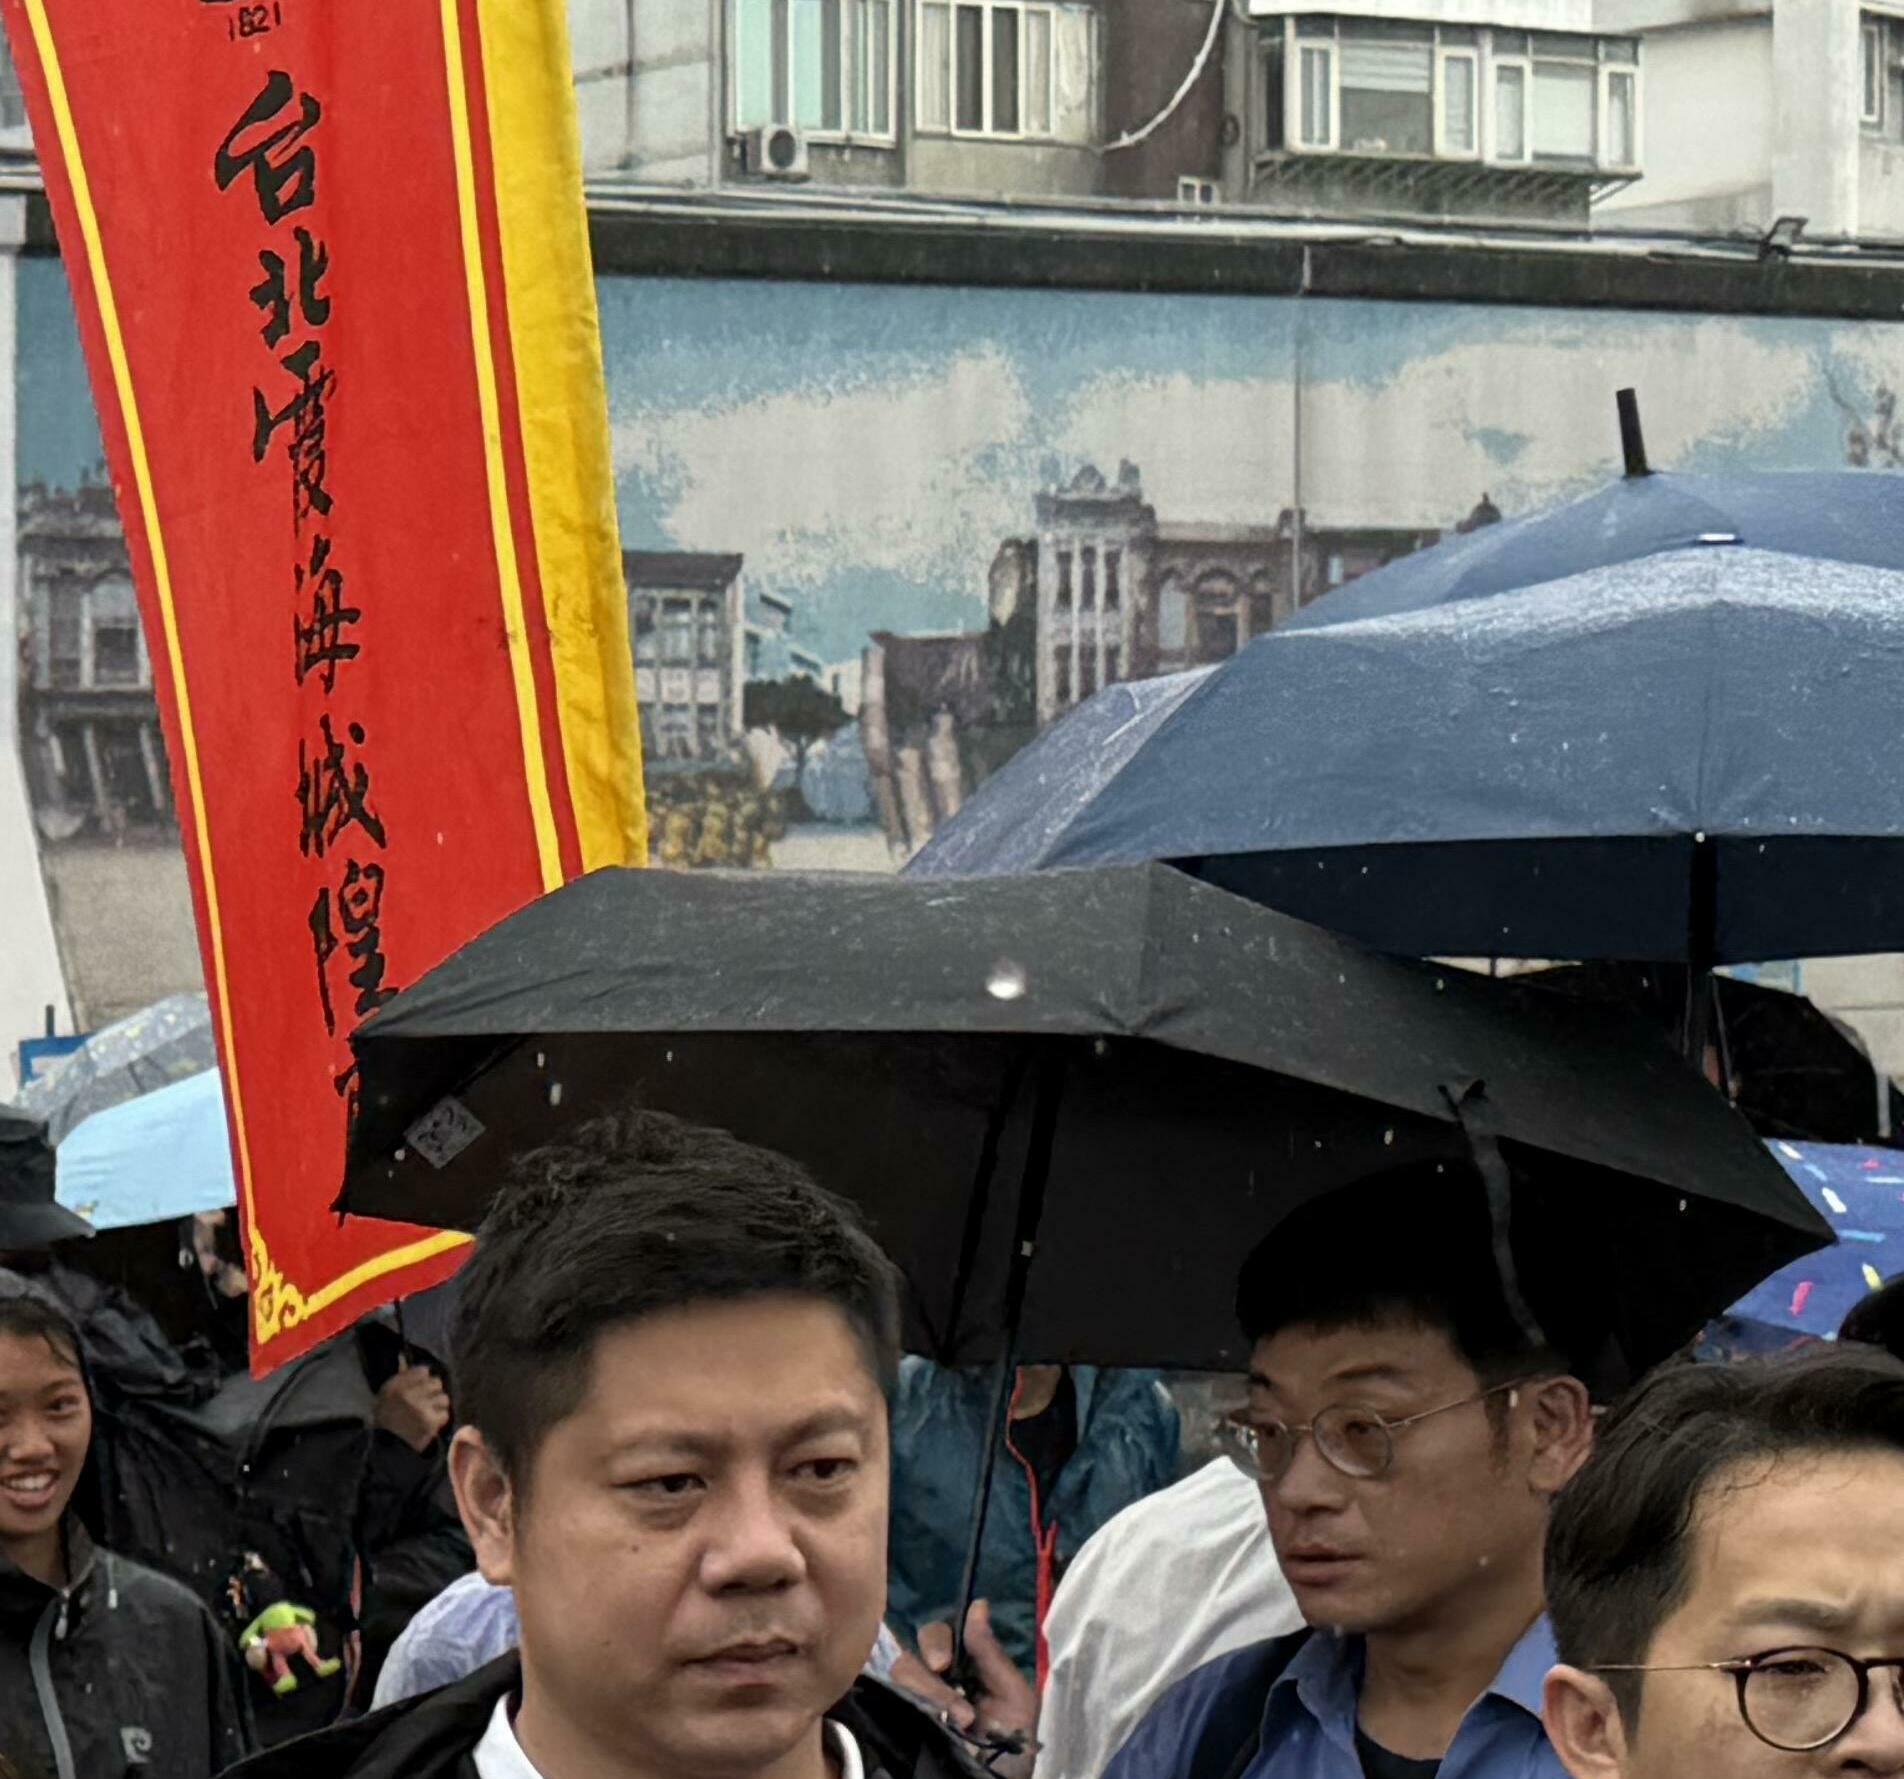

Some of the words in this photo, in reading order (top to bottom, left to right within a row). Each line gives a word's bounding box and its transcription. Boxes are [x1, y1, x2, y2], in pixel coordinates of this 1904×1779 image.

[214, 70, 397, 1122] 台北霞海城隍
